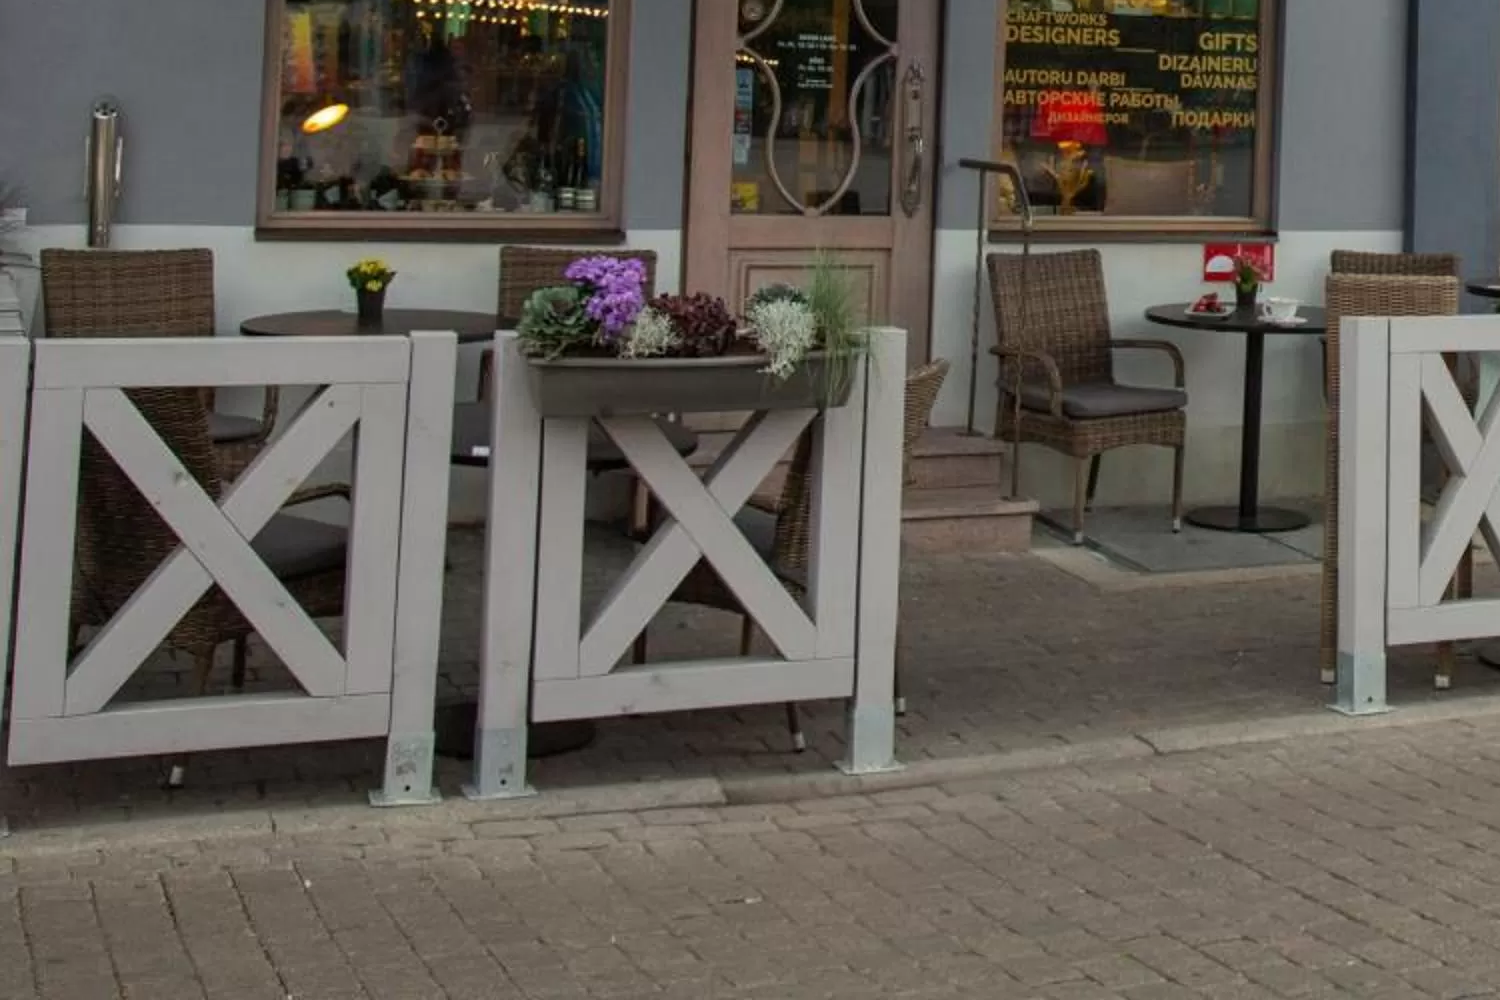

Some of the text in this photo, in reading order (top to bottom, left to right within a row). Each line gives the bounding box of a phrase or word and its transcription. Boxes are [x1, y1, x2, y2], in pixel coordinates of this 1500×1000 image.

[1006, 10, 1108, 26] CRAFTWORKS
[1005, 25, 1121, 46] DESIGNERS
[1199, 32, 1257, 52] GIFTS
[1004, 69, 1126, 87] AUTORU DARBI
